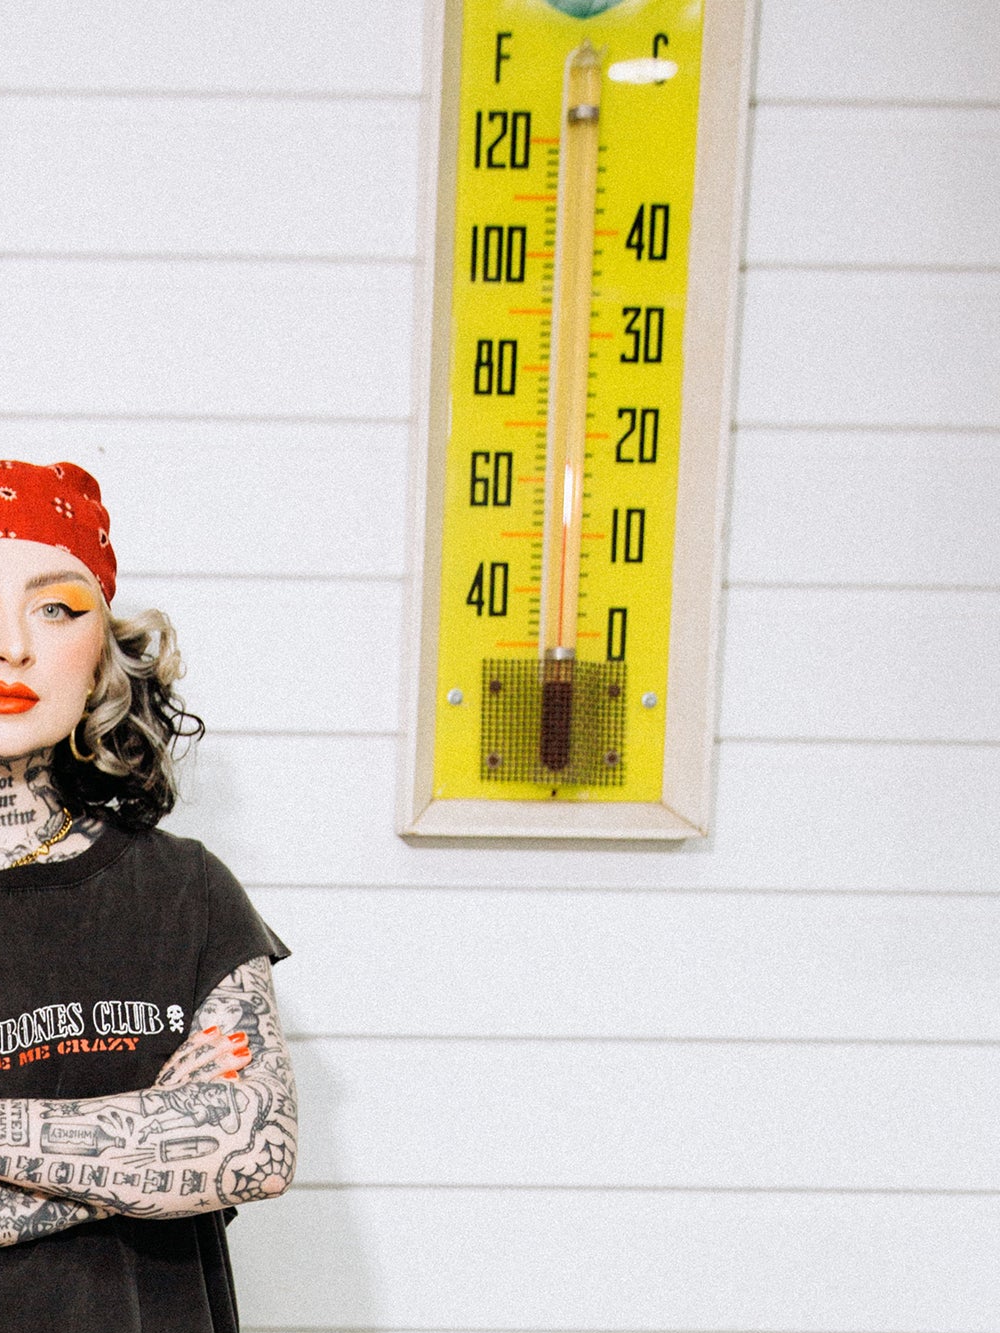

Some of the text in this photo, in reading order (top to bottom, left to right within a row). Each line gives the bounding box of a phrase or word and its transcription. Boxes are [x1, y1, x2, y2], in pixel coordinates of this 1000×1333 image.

[495, 32, 512, 83] F
[474, 111, 531, 168] 120
[470, 225, 527, 283] 100
[625, 203, 670, 261] 40
[620, 307, 664, 364] 30
[474, 340, 517, 396] 80
[616, 408, 660, 463] 20
[470, 452, 513, 507] 60
[610, 508, 645, 563] 10
[466, 562, 509, 617] 40
[607, 607, 628, 662] 0
[0, 1002, 84, 1054] BONES
[93, 1001, 164, 1035] CLUB
[19, 1045, 50, 1067] ME
[57, 1037, 139, 1055] CRAZY
[11, 1100, 23, 1142] NTED
[51, 1127, 92, 1139] WHISKEY
